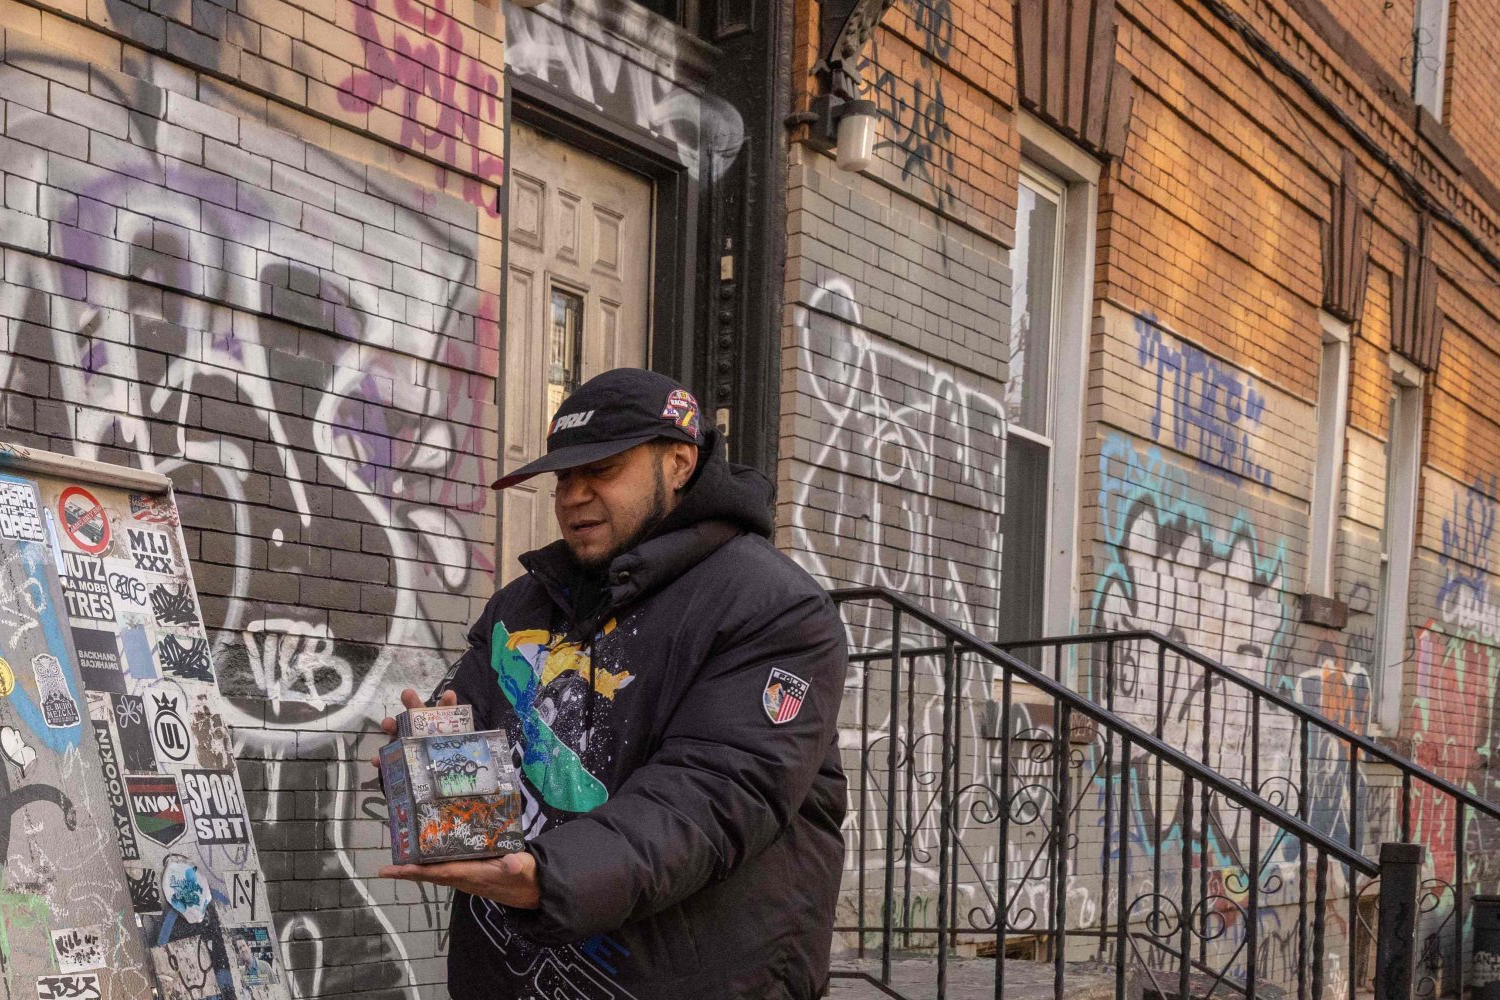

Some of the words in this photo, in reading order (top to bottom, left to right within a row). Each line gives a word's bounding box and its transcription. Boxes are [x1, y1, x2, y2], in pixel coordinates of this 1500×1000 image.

[127, 529, 169, 556] MIJ
[132, 552, 175, 575] XXX
[79, 581, 109, 593] MOBB
[64, 591, 115, 620] TRES
[78, 650, 117, 662] BACKHAND
[46, 709, 77, 719] MEZCAL
[159, 721, 186, 751] UL
[96, 727, 125, 808] COOKIN
[133, 795, 180, 813] KNOX
[184, 773, 242, 817] SPOR
[115, 814, 138, 859] STAY
[194, 817, 245, 840] SRT
